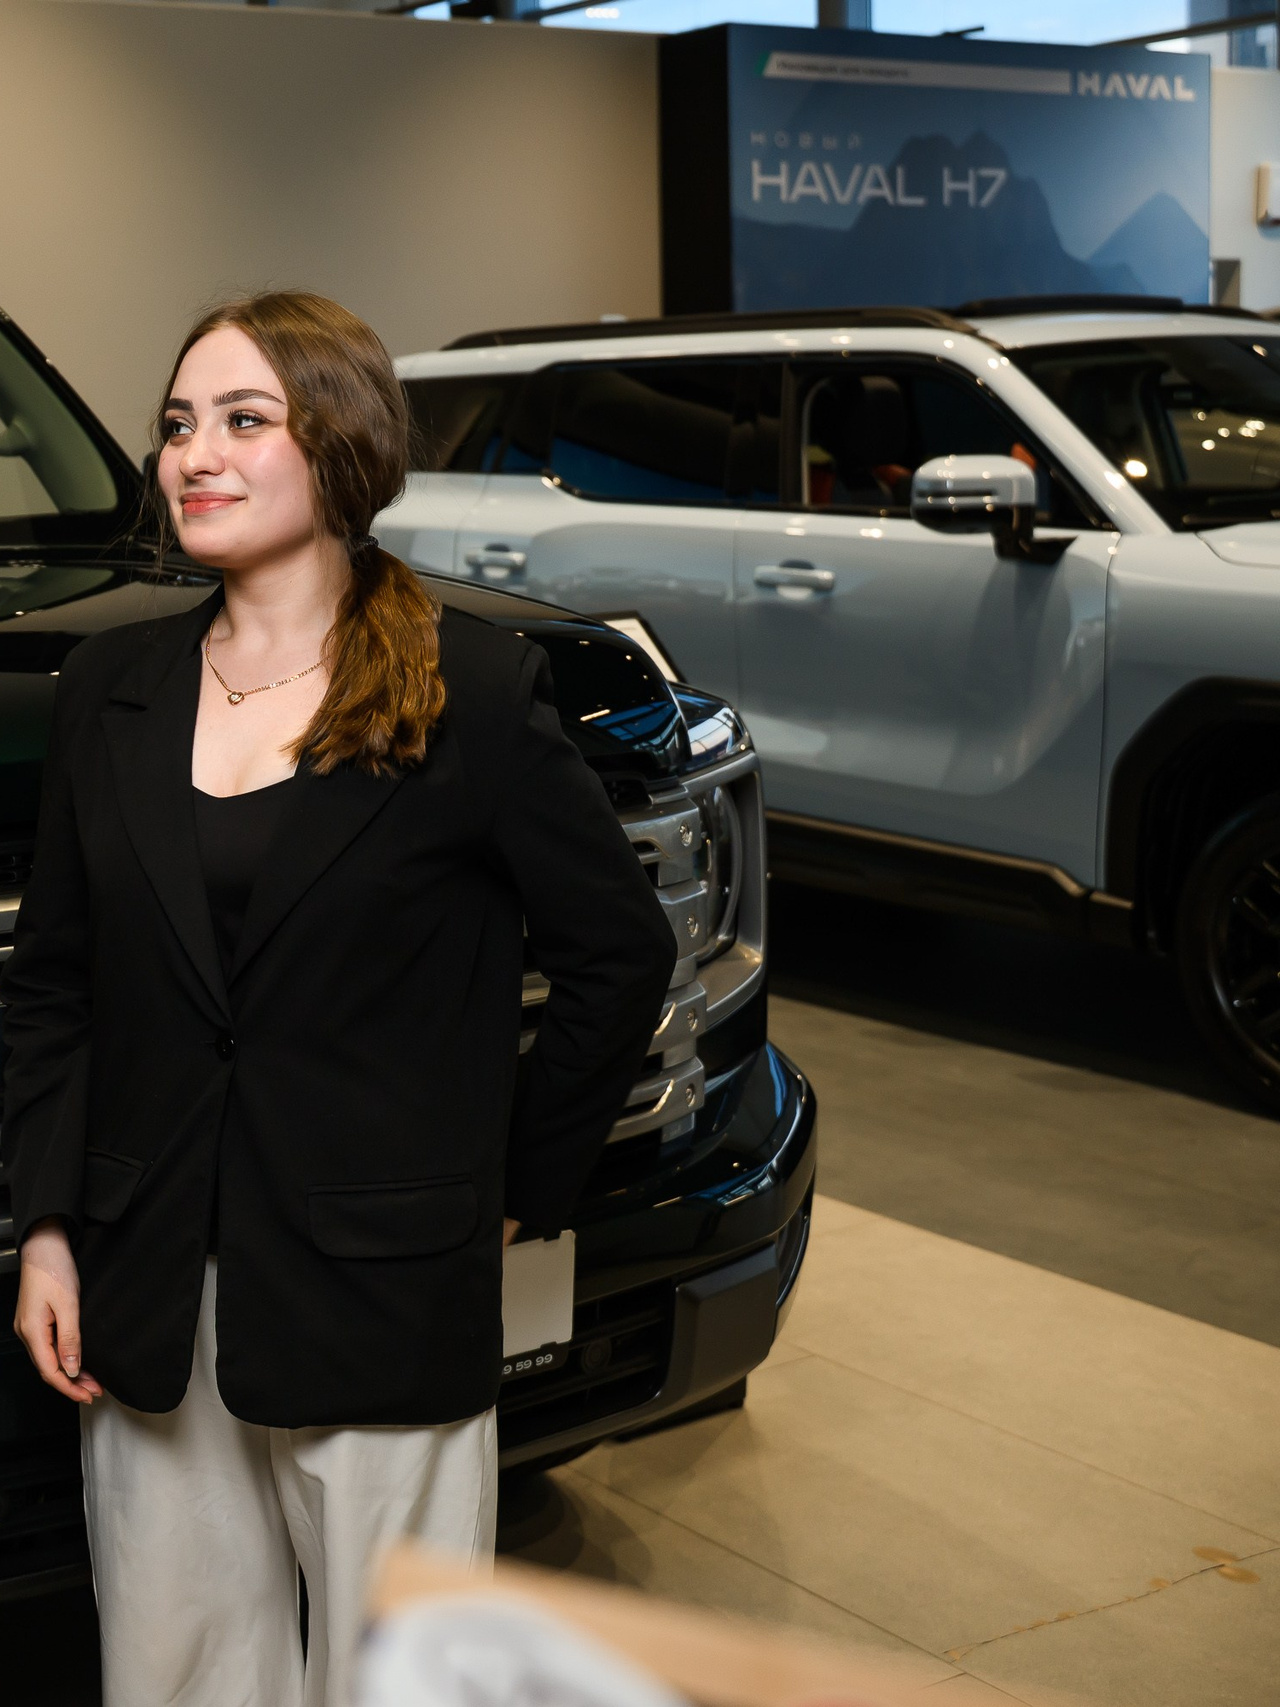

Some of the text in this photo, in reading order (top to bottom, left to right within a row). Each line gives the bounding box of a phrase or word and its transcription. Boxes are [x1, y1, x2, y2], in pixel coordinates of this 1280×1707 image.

[1077, 71, 1196, 101] HAVAL
[750, 159, 1008, 208] HAVAL H7
[501, 1353, 553, 1376] 9 59 99
